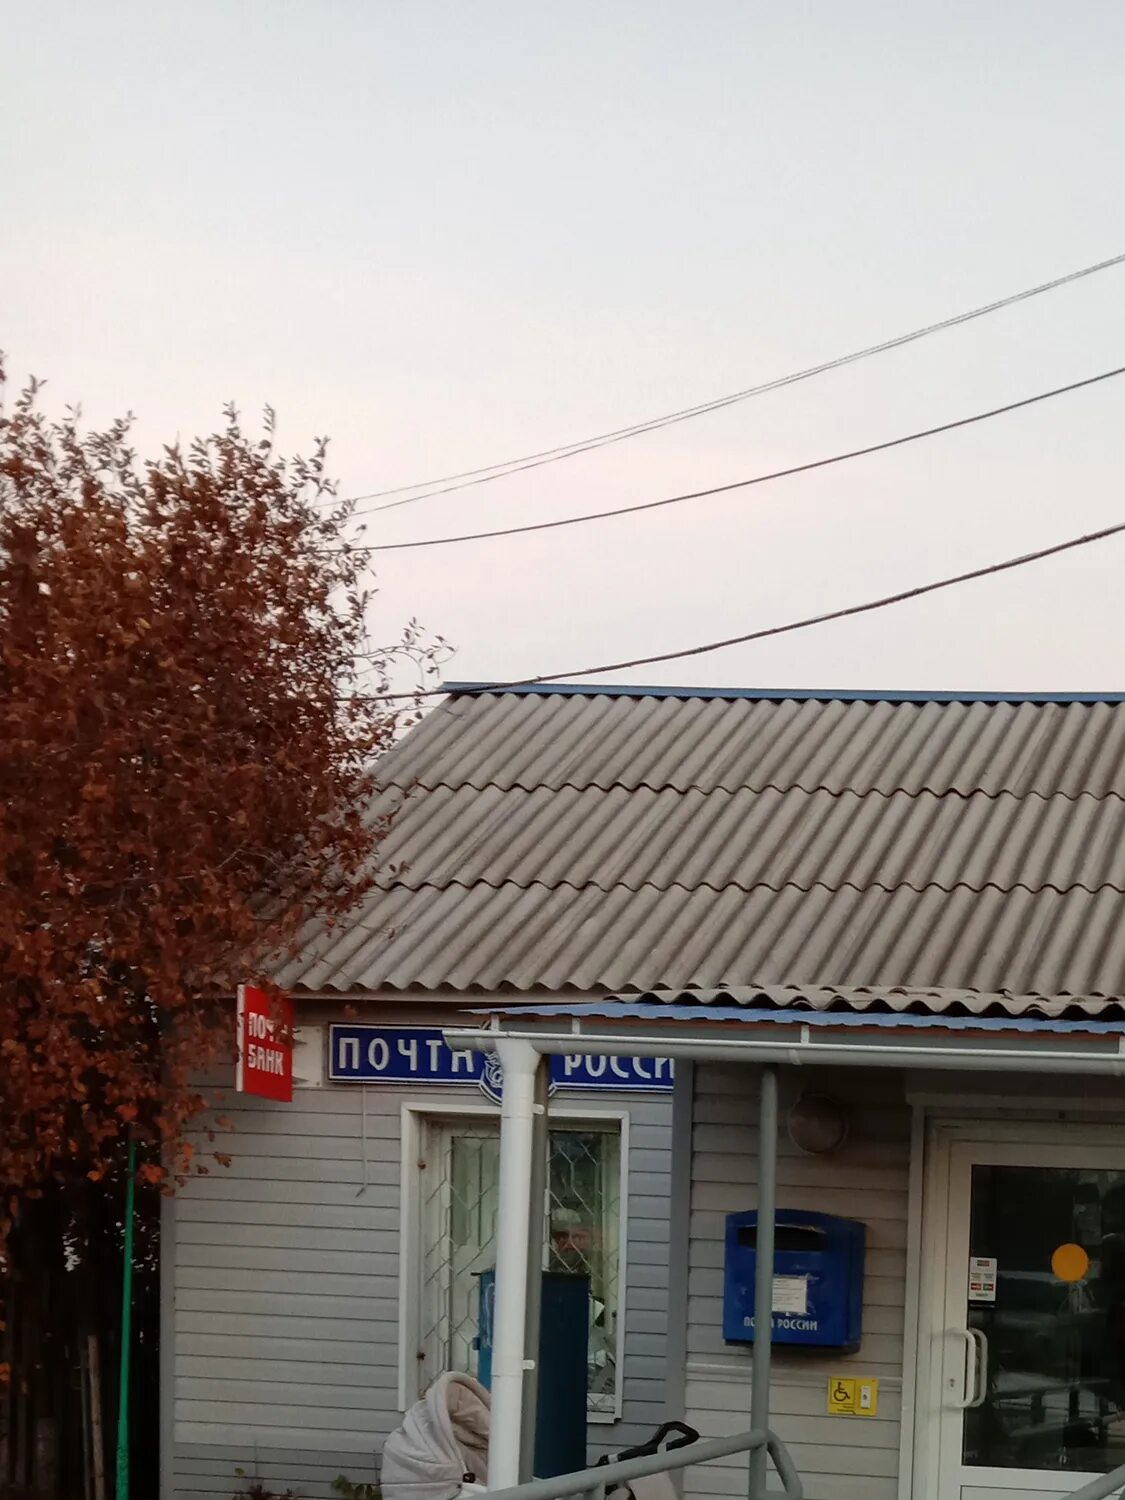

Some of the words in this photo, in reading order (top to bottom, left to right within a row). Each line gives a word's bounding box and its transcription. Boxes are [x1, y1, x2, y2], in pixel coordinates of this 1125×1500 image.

[247, 1043, 284, 1076] БАНК
[338, 1037, 475, 1073] ПОЧТА
[777, 1318, 818, 1331] РОССИИ
